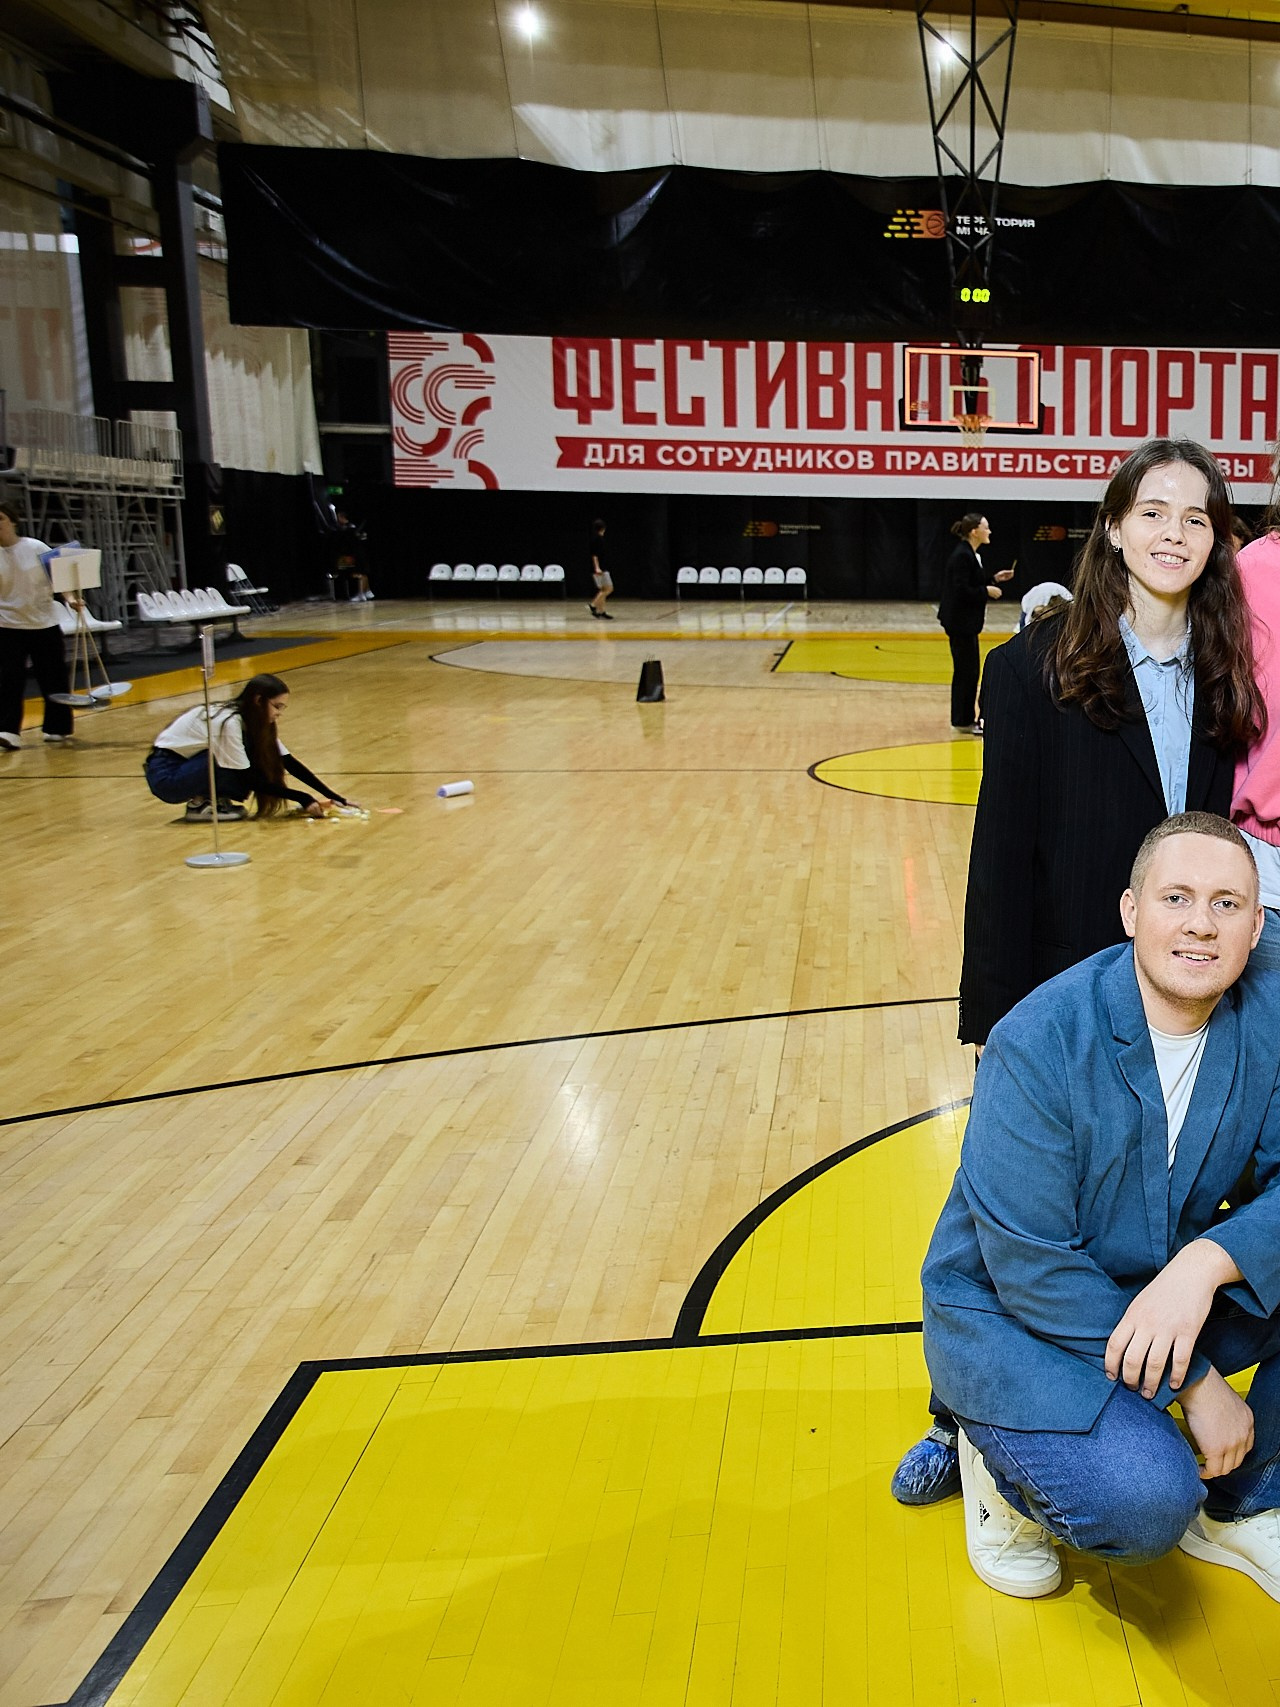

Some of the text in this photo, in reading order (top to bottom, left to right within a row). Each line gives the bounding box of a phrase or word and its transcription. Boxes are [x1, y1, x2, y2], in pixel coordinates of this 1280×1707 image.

[1017, 344, 1279, 442] СПОРТА
[584, 443, 1122, 476] ДЛЯ СОТРУДНИКОВ ПРАВИТЕЛЬСТВА
